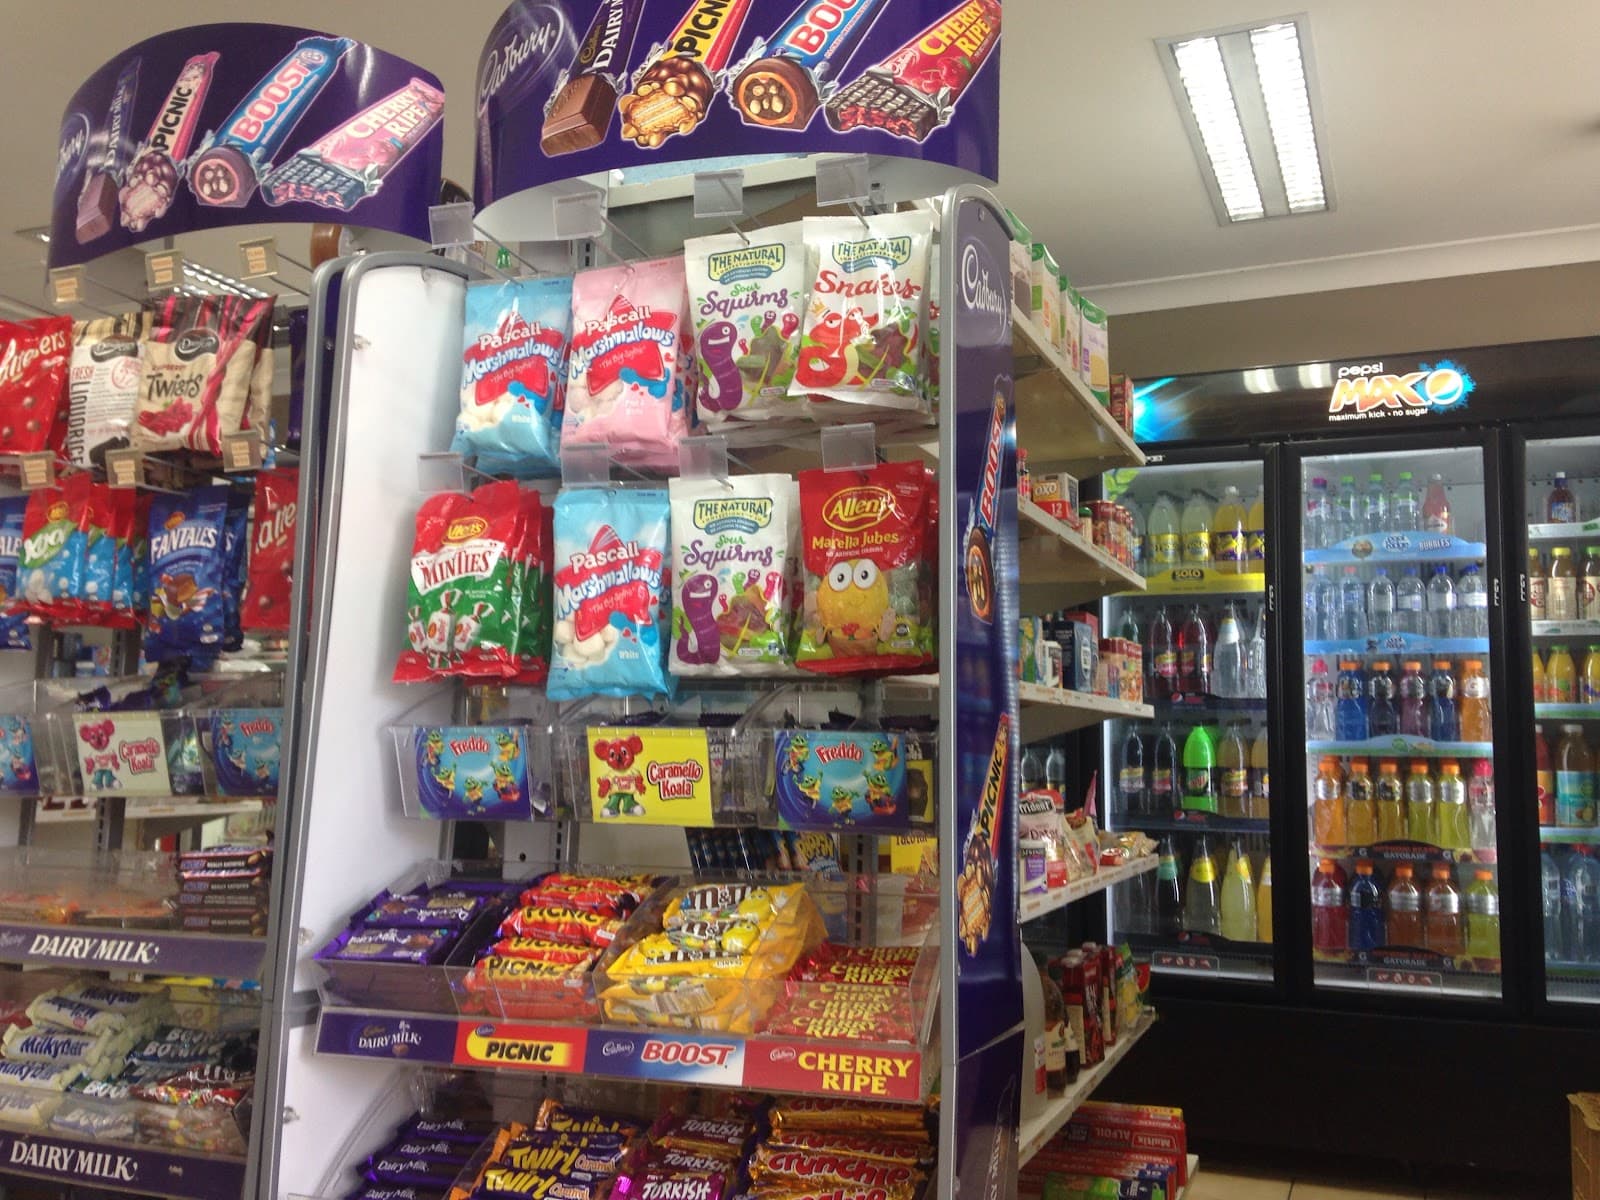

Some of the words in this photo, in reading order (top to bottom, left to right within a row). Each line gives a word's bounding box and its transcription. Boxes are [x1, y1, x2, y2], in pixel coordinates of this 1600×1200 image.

[592, 6, 624, 68] DAIRY
[674, 0, 729, 57] PICN
[919, 0, 985, 56] CHERRY
[954, 18, 992, 58] RIPE
[478, 22, 552, 118] Cadbury
[230, 56, 312, 142] BOOST
[151, 86, 193, 152] PICNIC
[383, 103, 428, 138] RIPE
[712, 255, 732, 273] THE
[733, 247, 781, 264] NATURAL
[838, 242, 858, 257] THE
[858, 239, 907, 256] NATURAL
[730, 282, 761, 297] Sour
[814, 270, 922, 300] Snakes
[961, 244, 1007, 314] Cadbury
[700, 288, 789, 318] Squirms
[586, 306, 653, 335] Pascall
[478, 321, 542, 350] Pascall
[462, 338, 561, 388] Marshmallows
[571, 322, 675, 379] Marshmallows
[1338, 361, 1383, 379] pepsi
[146, 370, 204, 401] Twists
[1328, 371, 1432, 413] MAX
[68, 380, 91, 465] LIQUORICE
[1328, 412, 1367, 422] maximum
[1368, 410, 1386, 419] kick
[1392, 409, 1404, 417] no
[1405, 408, 1429, 418] sugar
[978, 411, 1003, 528] BOOST
[1034, 482, 1057, 496] OXO
[698, 503, 719, 520] THE
[720, 501, 768, 518] NATURAL
[828, 495, 887, 522] Allen
[1051, 503, 1063, 516] 12
[150, 526, 218, 565] FANTALES
[715, 534, 746, 549] Sour
[812, 535, 860, 550] Marella
[861, 530, 899, 548] Jubes
[419, 547, 493, 590] MINTIES
[570, 540, 640, 575] Pascall
[684, 539, 773, 571] Squirms
[556, 560, 661, 622] Marshmallows
[450, 735, 490, 756] Freddo
[815, 741, 864, 765] Freddo
[648, 759, 703, 782] Caramello
[660, 779, 693, 799] Koala
[979, 744, 1005, 838] PICNIC
[1359, 848, 1368, 857] G
[1442, 850, 1452, 859] G
[28, 934, 99, 956] DAIRY
[95, 939, 154, 964] MILK
[488, 956, 562, 976] PICNIC
[358, 1034, 391, 1049] DAIRY
[391, 1030, 422, 1046] MILK
[485, 1041, 555, 1062] PICNIC
[602, 1040, 634, 1056] Cadbury
[641, 1039, 736, 1066] BOOST
[798, 1050, 914, 1078] CHERRY
[821, 1071, 888, 1095] RIPE
[680, 1119, 744, 1136] TURKISH
[10, 1140, 76, 1172] DAIRY
[74, 1151, 138, 1182] MILK
[378, 1160, 406, 1174] Dairy
[663, 1153, 730, 1173] TURKISH
[767, 1152, 912, 1186] Crunchie
[642, 1176, 712, 1200] TURKISH
